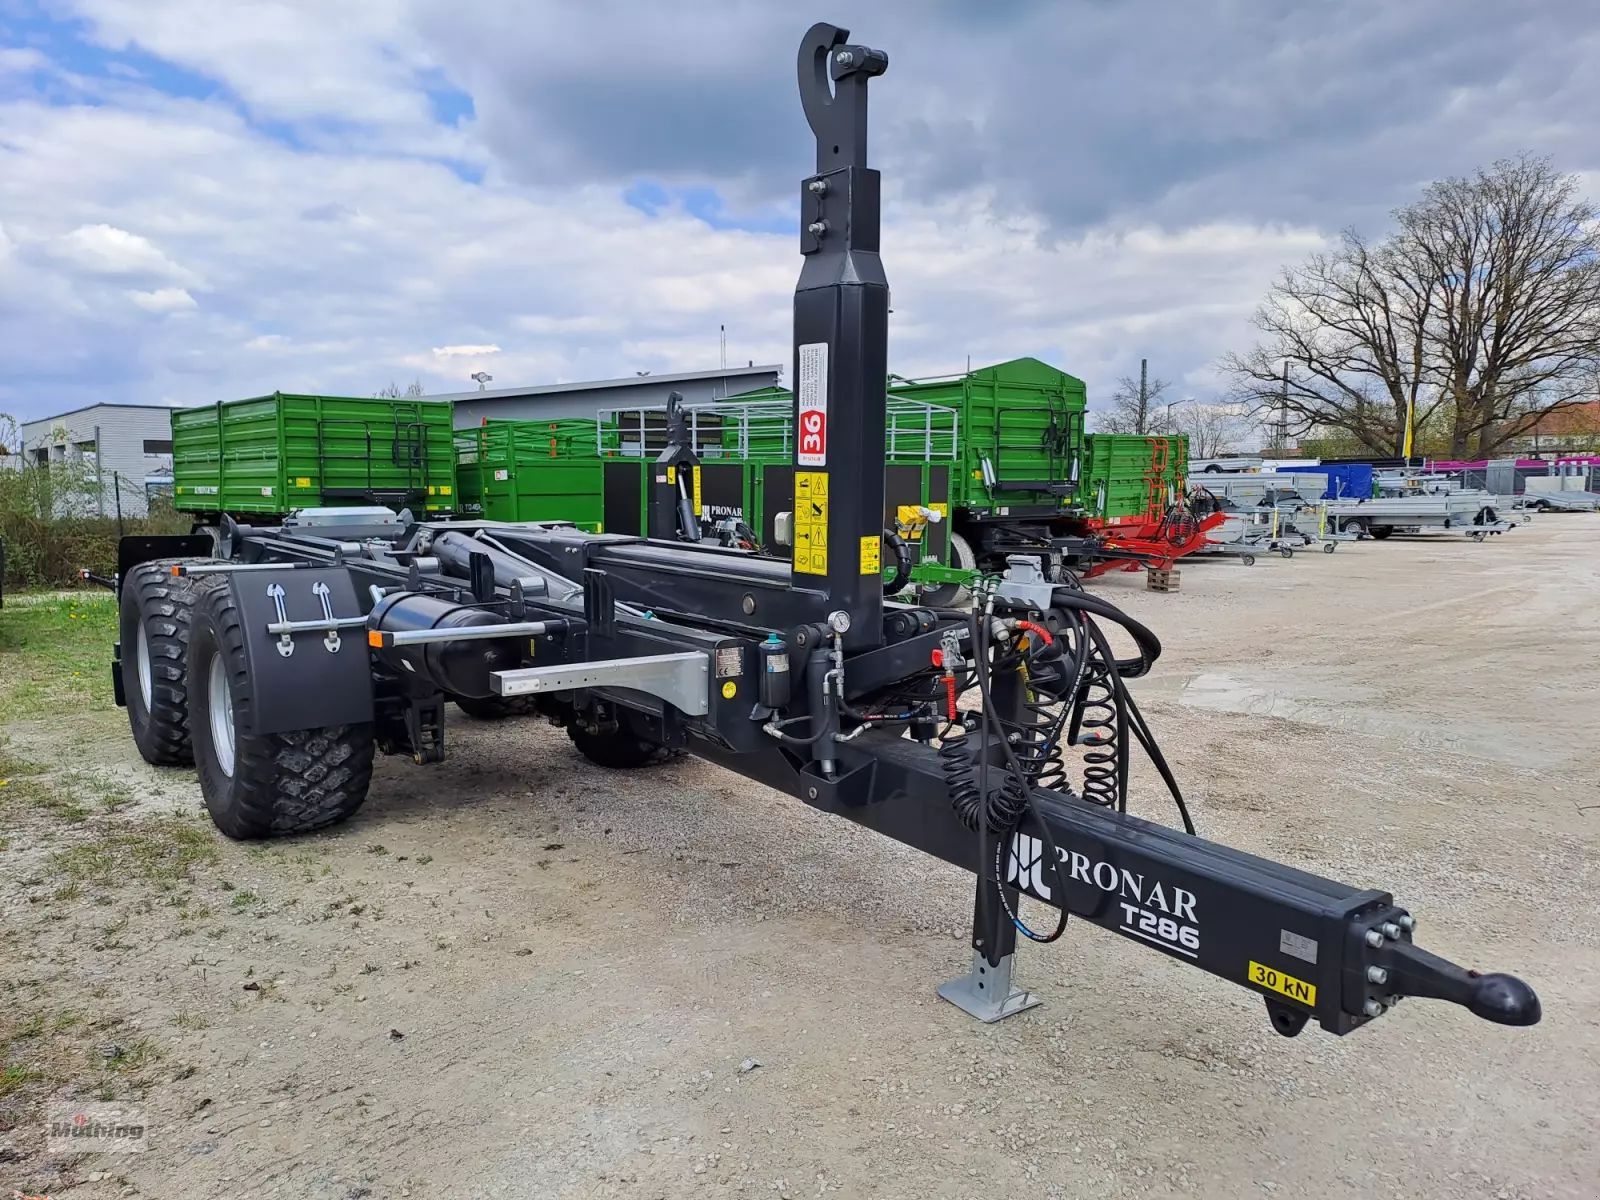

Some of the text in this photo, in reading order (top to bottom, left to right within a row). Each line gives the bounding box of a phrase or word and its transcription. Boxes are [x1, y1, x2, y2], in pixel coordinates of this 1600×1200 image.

[804, 415, 821, 451] 36
[711, 505, 743, 517] PRONAR
[1050, 845, 1200, 924] PRONAR
[1119, 901, 1200, 950] T286
[1255, 966, 1309, 1001] 30 kN
